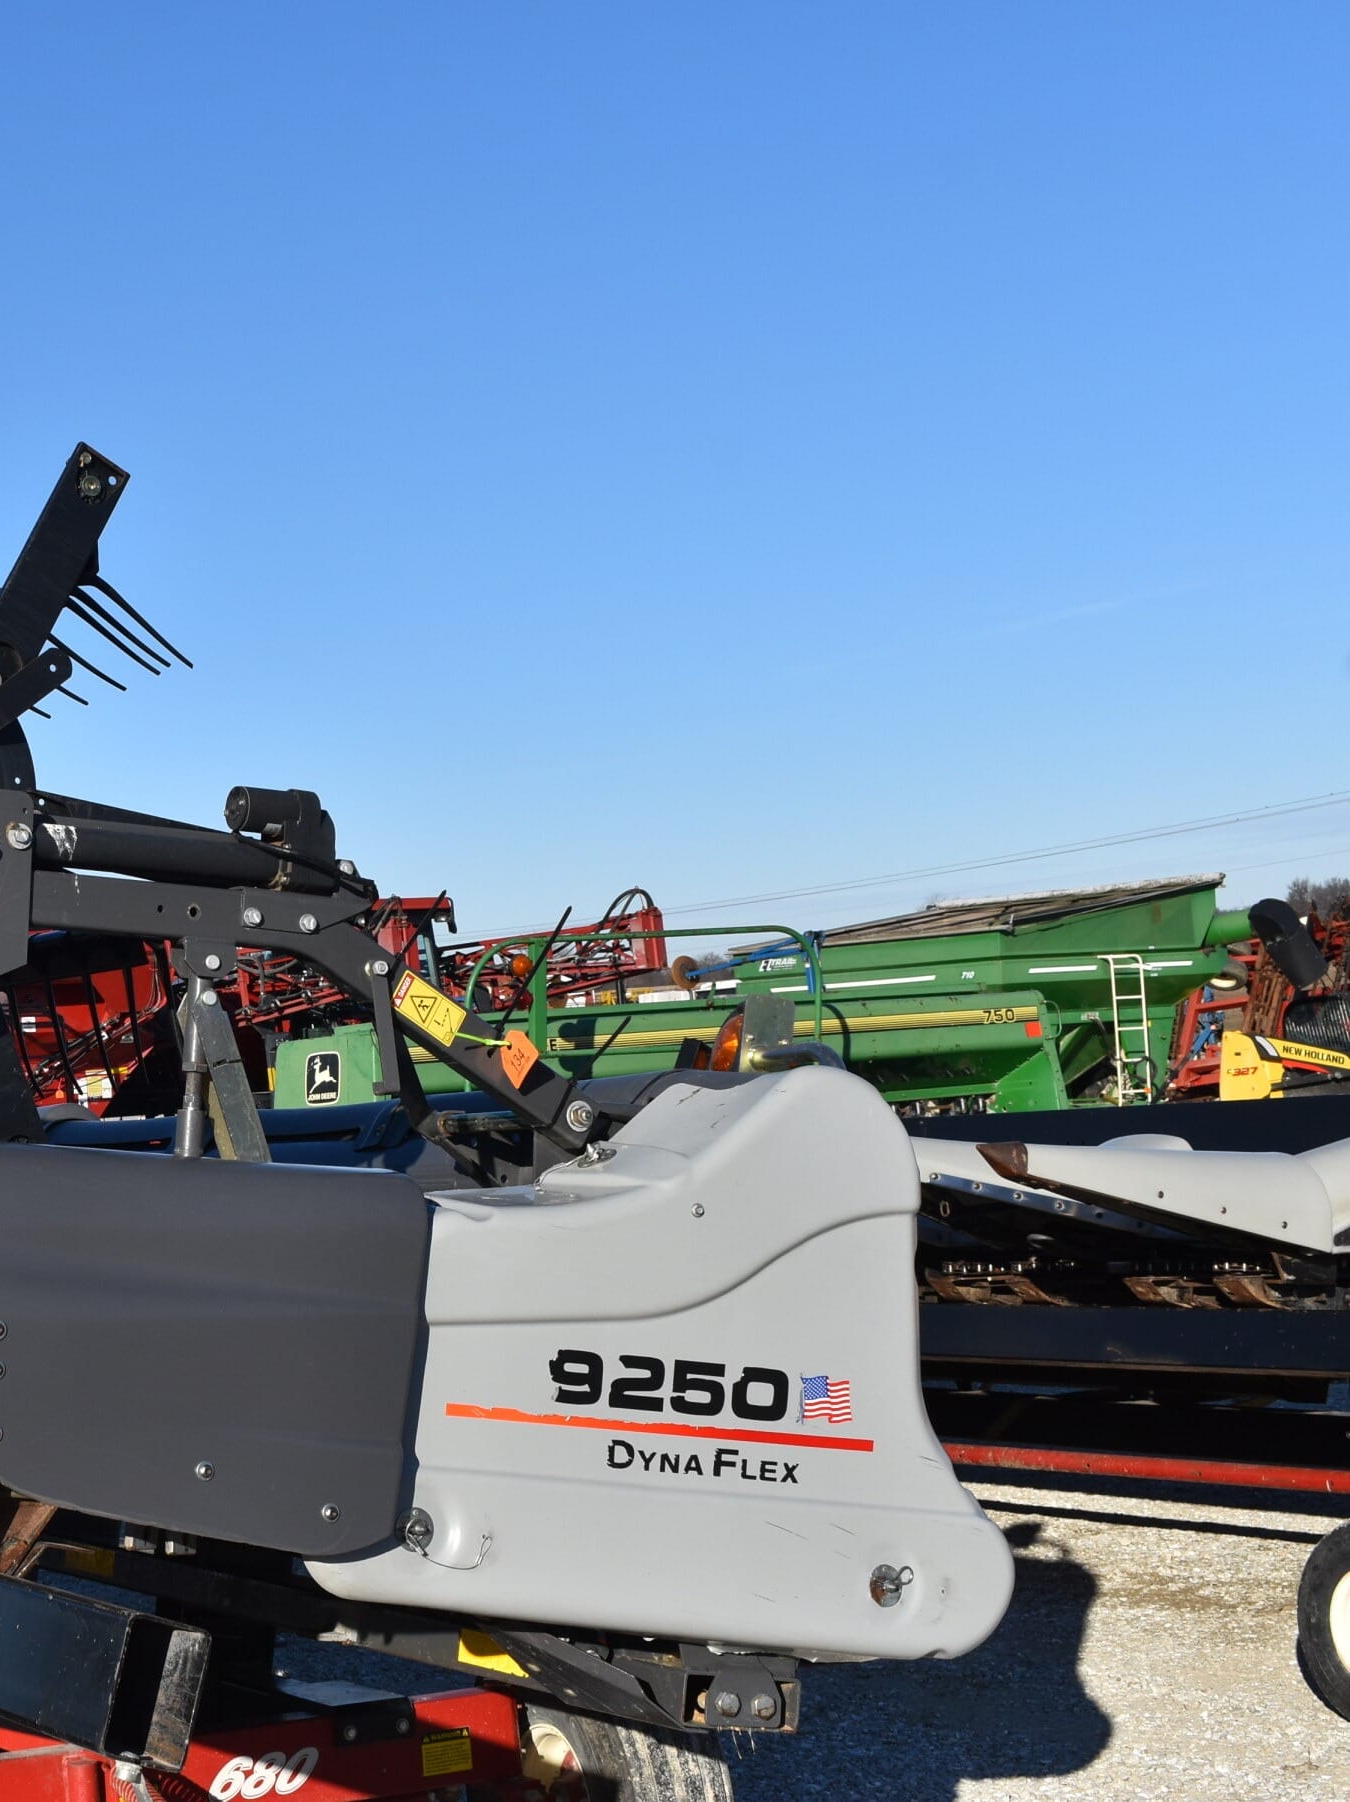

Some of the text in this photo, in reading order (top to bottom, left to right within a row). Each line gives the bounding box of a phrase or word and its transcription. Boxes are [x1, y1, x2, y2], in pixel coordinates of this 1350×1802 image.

[982, 1008, 1015, 1023] 750
[1282, 1045, 1345, 1065] NEW HOLLAND
[307, 1091, 337, 1102] JOHN DEERE
[549, 1349, 789, 1422] 9250
[208, 1746, 320, 1802] 680
